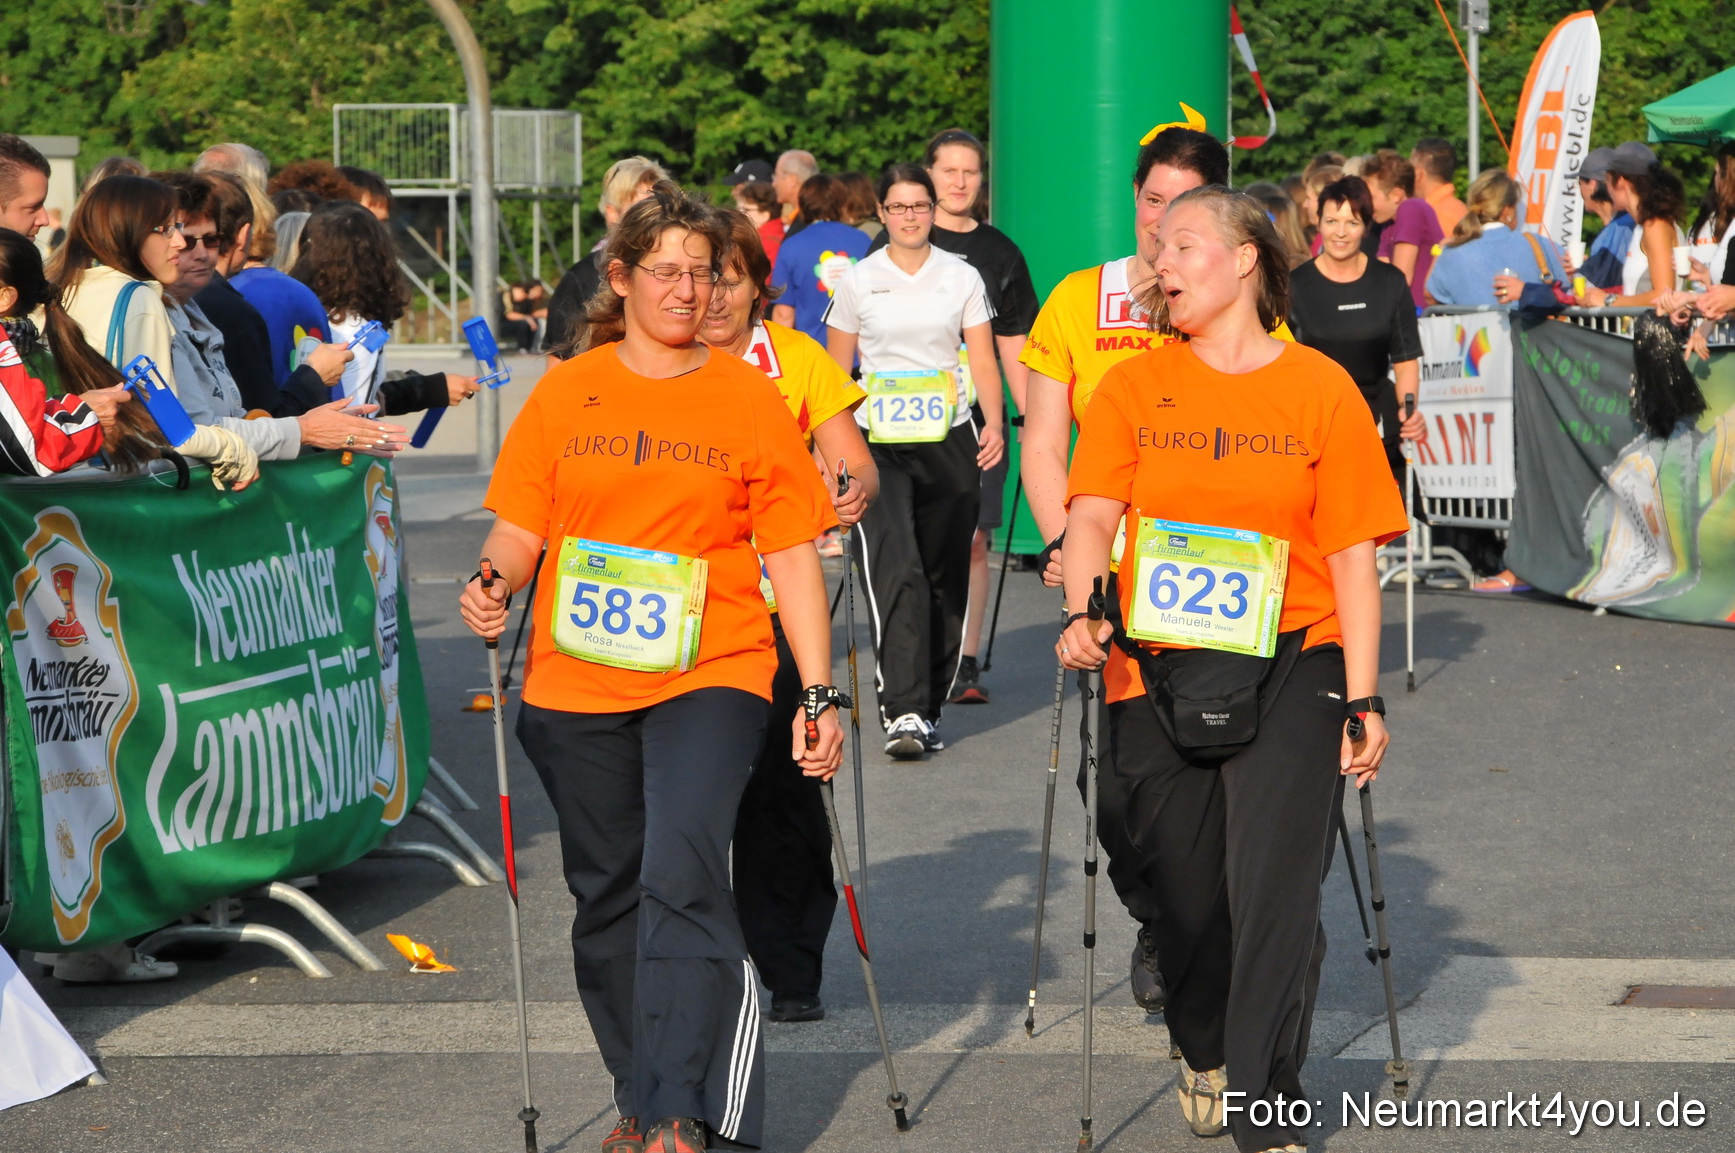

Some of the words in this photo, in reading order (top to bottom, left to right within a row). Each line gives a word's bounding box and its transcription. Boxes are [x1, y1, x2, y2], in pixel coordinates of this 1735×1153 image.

[1524, 66, 1570, 225] EBL
[1561, 94, 1591, 250] ww.klebl.de
[1096, 336, 1152, 351] MAX
[1422, 359, 1463, 382] hmann
[872, 396, 944, 422] 1236
[563, 435, 629, 458] EURO
[657, 440, 730, 472] POLES
[1138, 427, 1208, 450] EURO
[1235, 434, 1310, 457] POLES
[1416, 413, 1494, 465] RINT
[1156, 543, 1206, 558] firmenlauf
[577, 563, 623, 579] firmenlauf
[171, 522, 343, 667] Neumarkter
[1149, 562, 1248, 620] 623
[569, 581, 667, 640] 583
[1160, 612, 1211, 629] Manuela
[584, 631, 613, 647] Rosa
[28, 690, 115, 746] mmsbräu
[807, 688, 817, 715] LEKI
[145, 646, 378, 855] Lammsbräu
